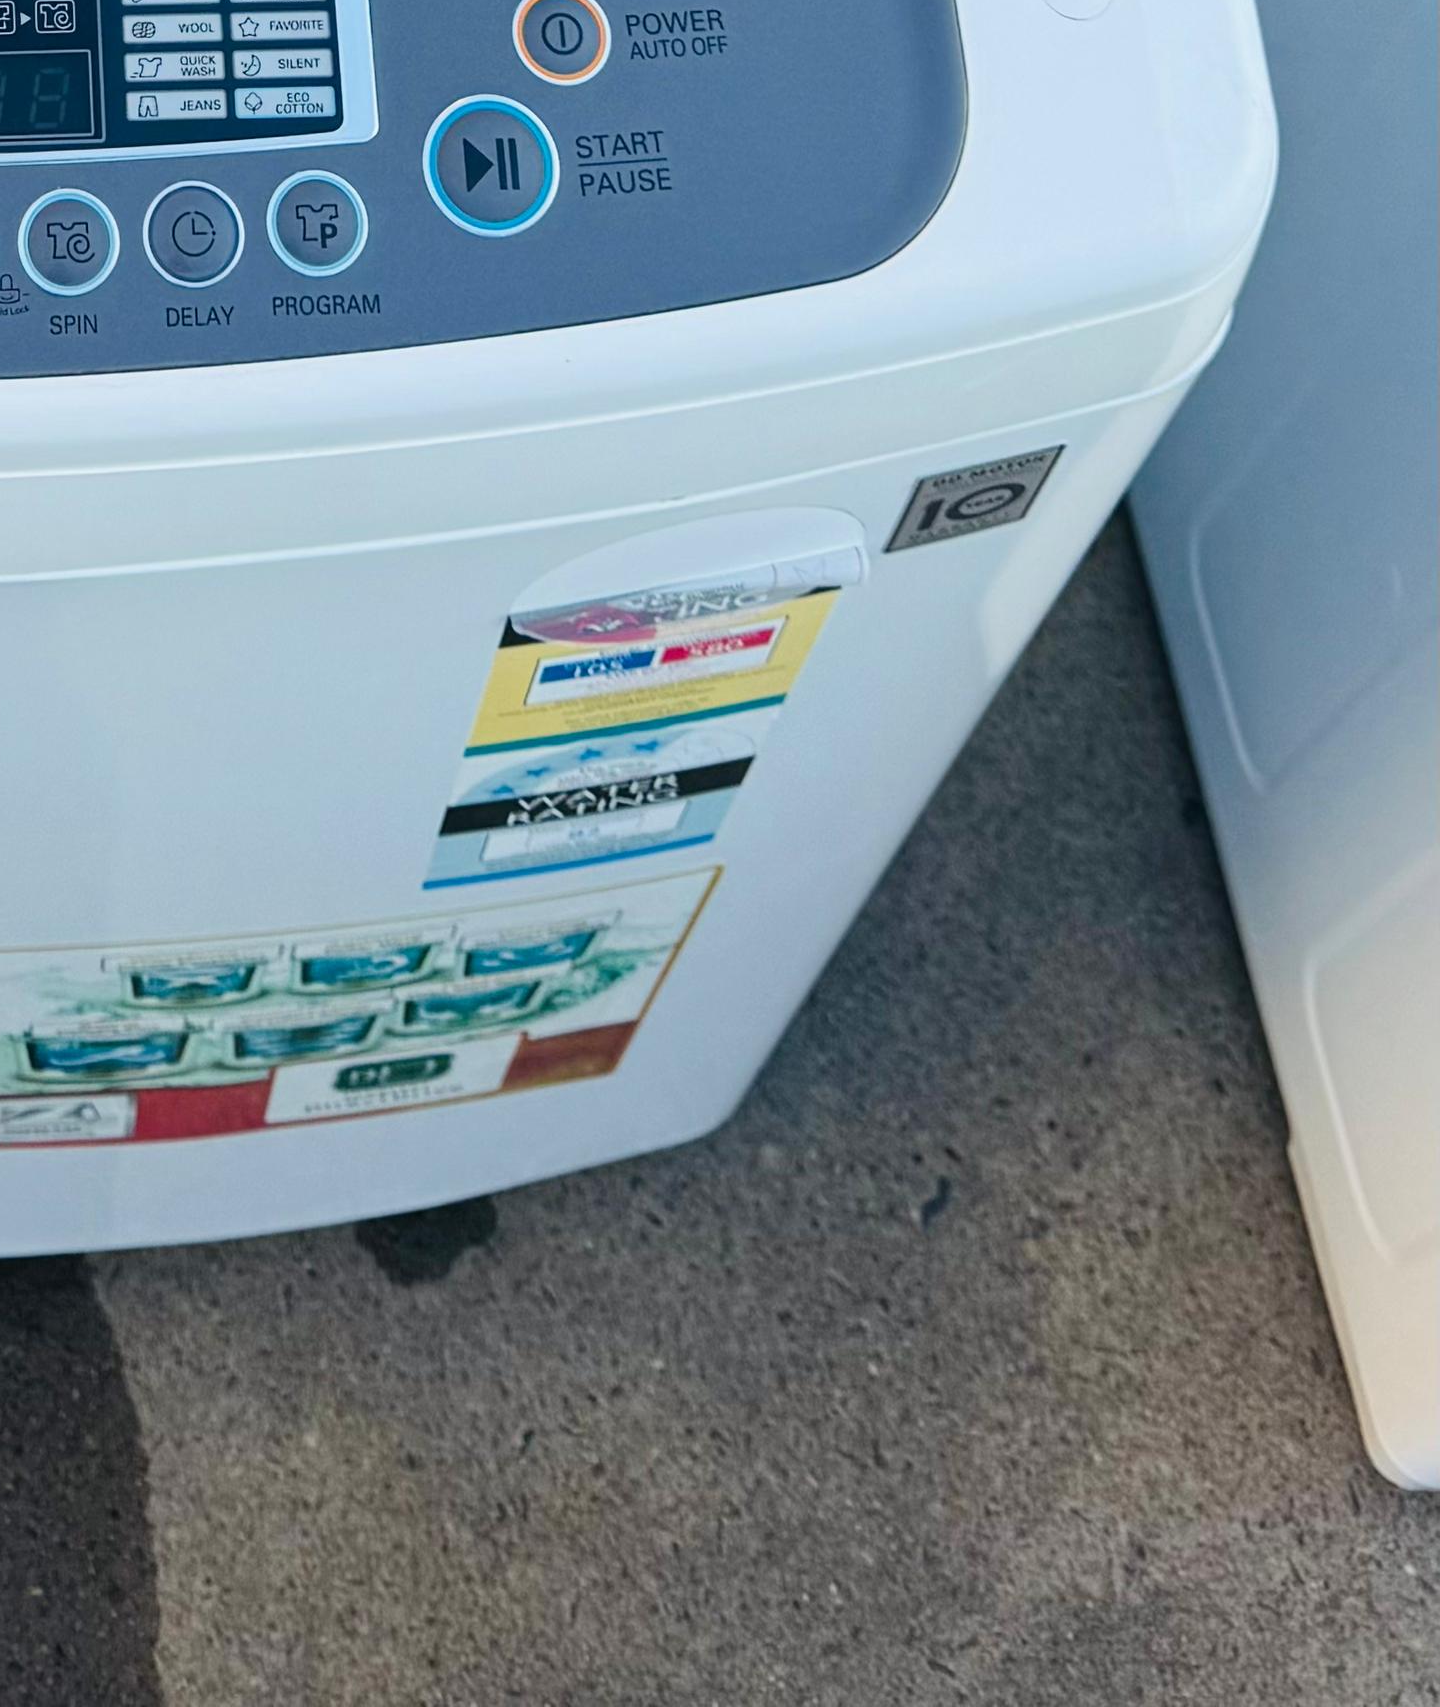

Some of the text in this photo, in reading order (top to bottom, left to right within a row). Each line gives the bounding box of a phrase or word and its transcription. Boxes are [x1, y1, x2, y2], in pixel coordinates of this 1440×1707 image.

[178, 22, 215, 34] WOOL
[269, 19, 325, 32] FAVORITE
[624, 8, 725, 36] POWER
[629, 35, 728, 60] AUTO OFF
[179, 55, 217, 67] QUICK
[277, 58, 321, 70] SILENT
[180, 66, 216, 77] WASH
[286, 91, 310, 103] ECO
[179, 99, 222, 112] JEANS
[275, 102, 325, 115] COTTON
[575, 130, 664, 160] START
[578, 167, 673, 198] PAUSE
[10, 305, 30, 315] Lock
[271, 293, 382, 317] PROGRAM
[165, 305, 235, 328] DELAY
[49, 314, 98, 336] SPIN
